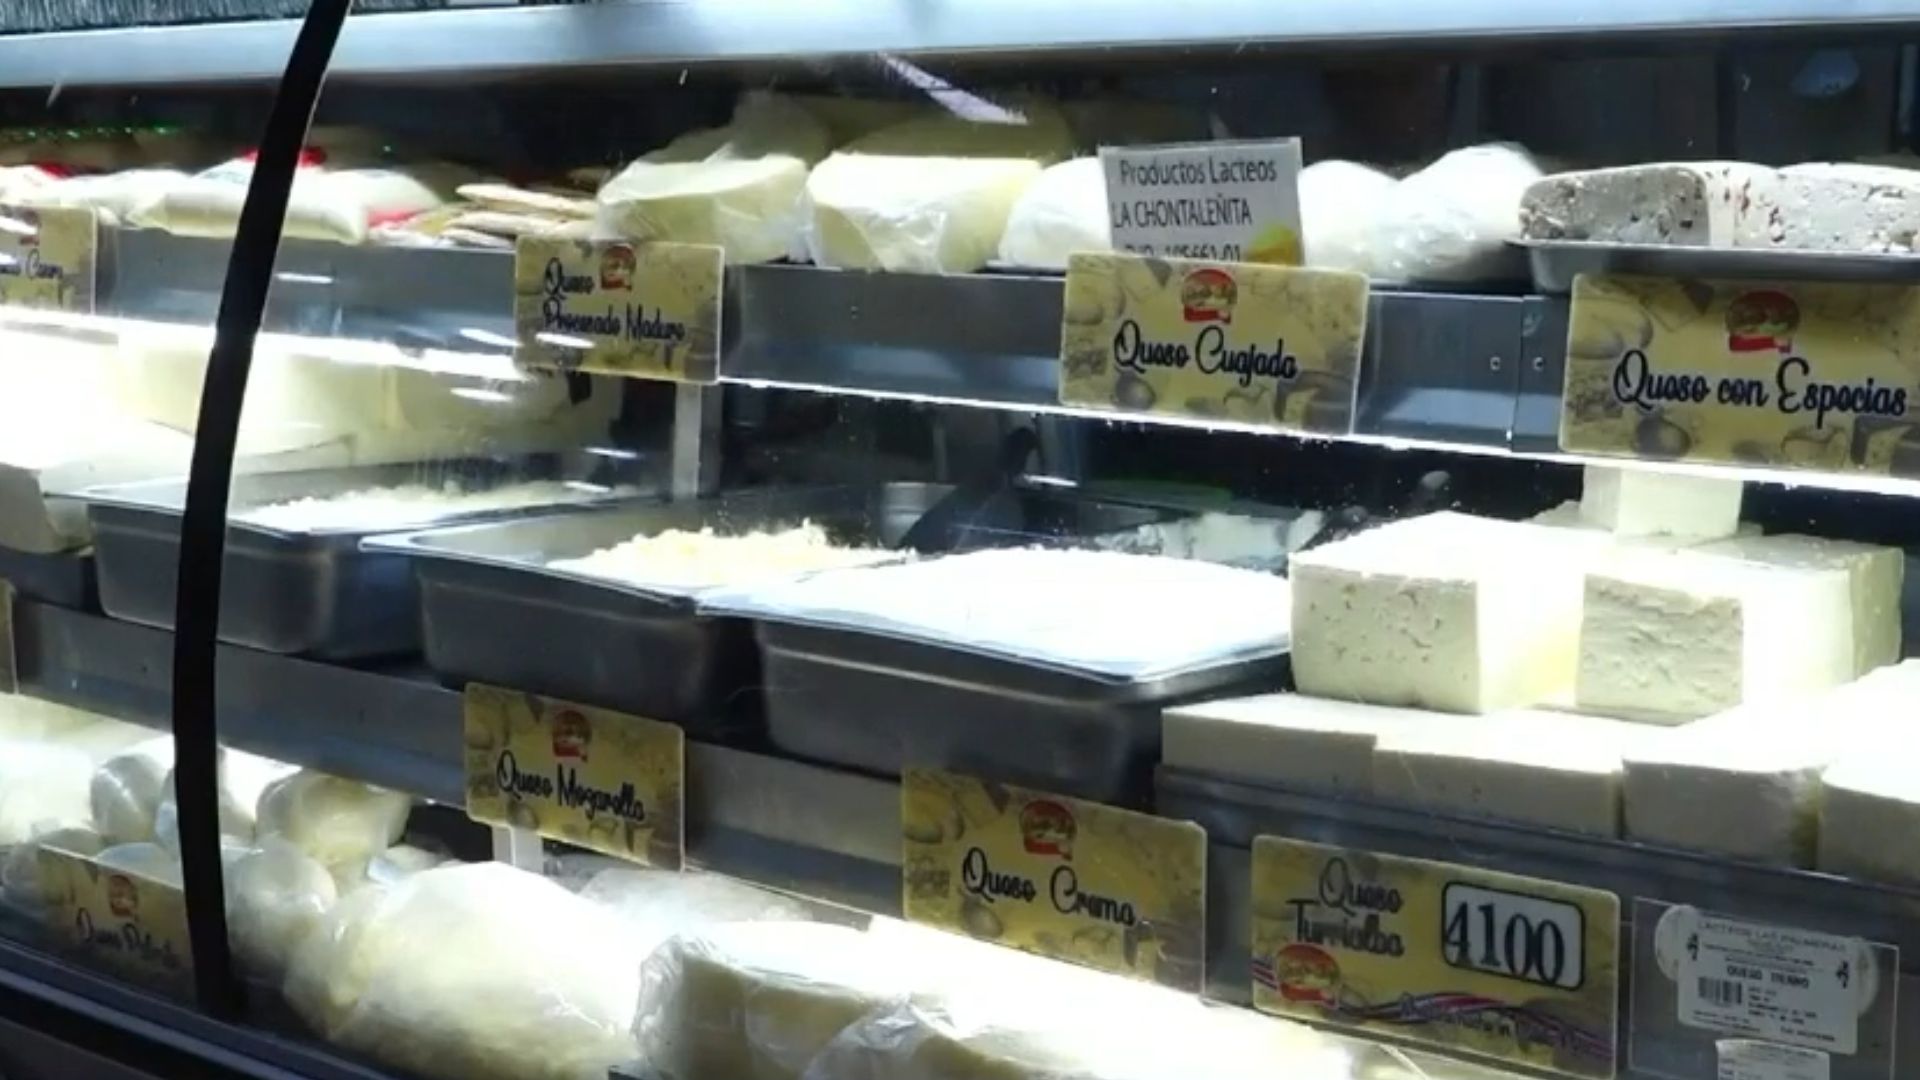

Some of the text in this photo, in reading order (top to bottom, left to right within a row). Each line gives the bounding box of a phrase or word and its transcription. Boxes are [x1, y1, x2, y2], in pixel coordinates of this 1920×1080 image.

[1120, 156, 1278, 186] Productos Lacteos
[1112, 193, 1253, 228] LA CHONTALEÑITA
[544, 256, 594, 299] Queso
[1113, 319, 1298, 387] Queso Cuajada
[1613, 349, 1907, 430] Queso con Especias
[496, 749, 553, 801] Queso
[962, 847, 1136, 927] Queso Crema
[1319, 856, 1403, 916] Queso
[1447, 901, 1565, 984] 4100
